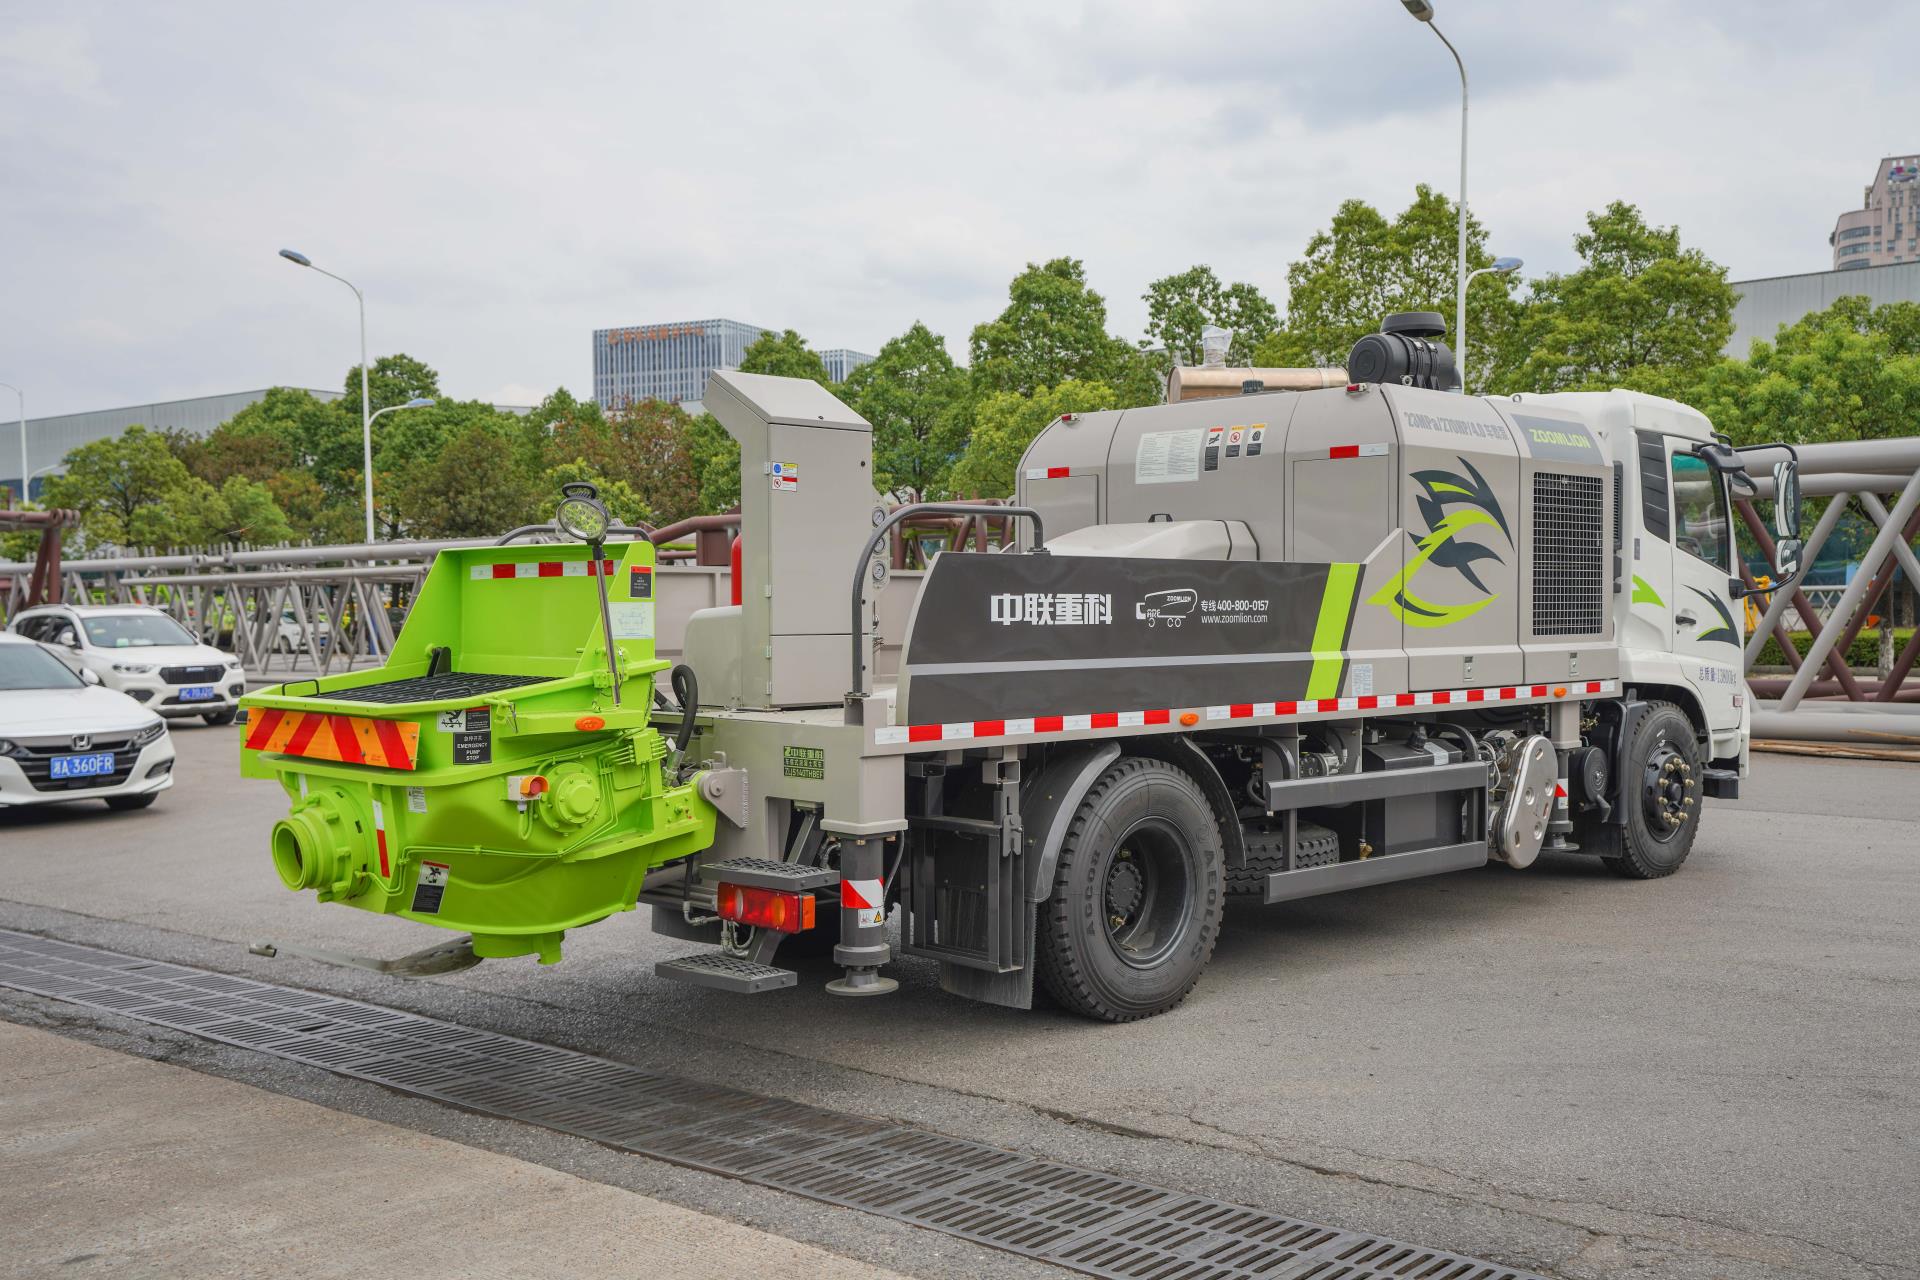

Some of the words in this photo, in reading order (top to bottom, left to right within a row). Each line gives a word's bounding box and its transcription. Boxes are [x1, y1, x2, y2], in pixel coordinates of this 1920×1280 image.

[1528, 428, 1592, 449] ZOOMLION
[990, 593, 1113, 625] 中联重科
[1217, 600, 1269, 611] 400-800-0157
[1201, 613, 1268, 624] www.zoomlion.com
[1190, 849, 1218, 961] AEOLUS
